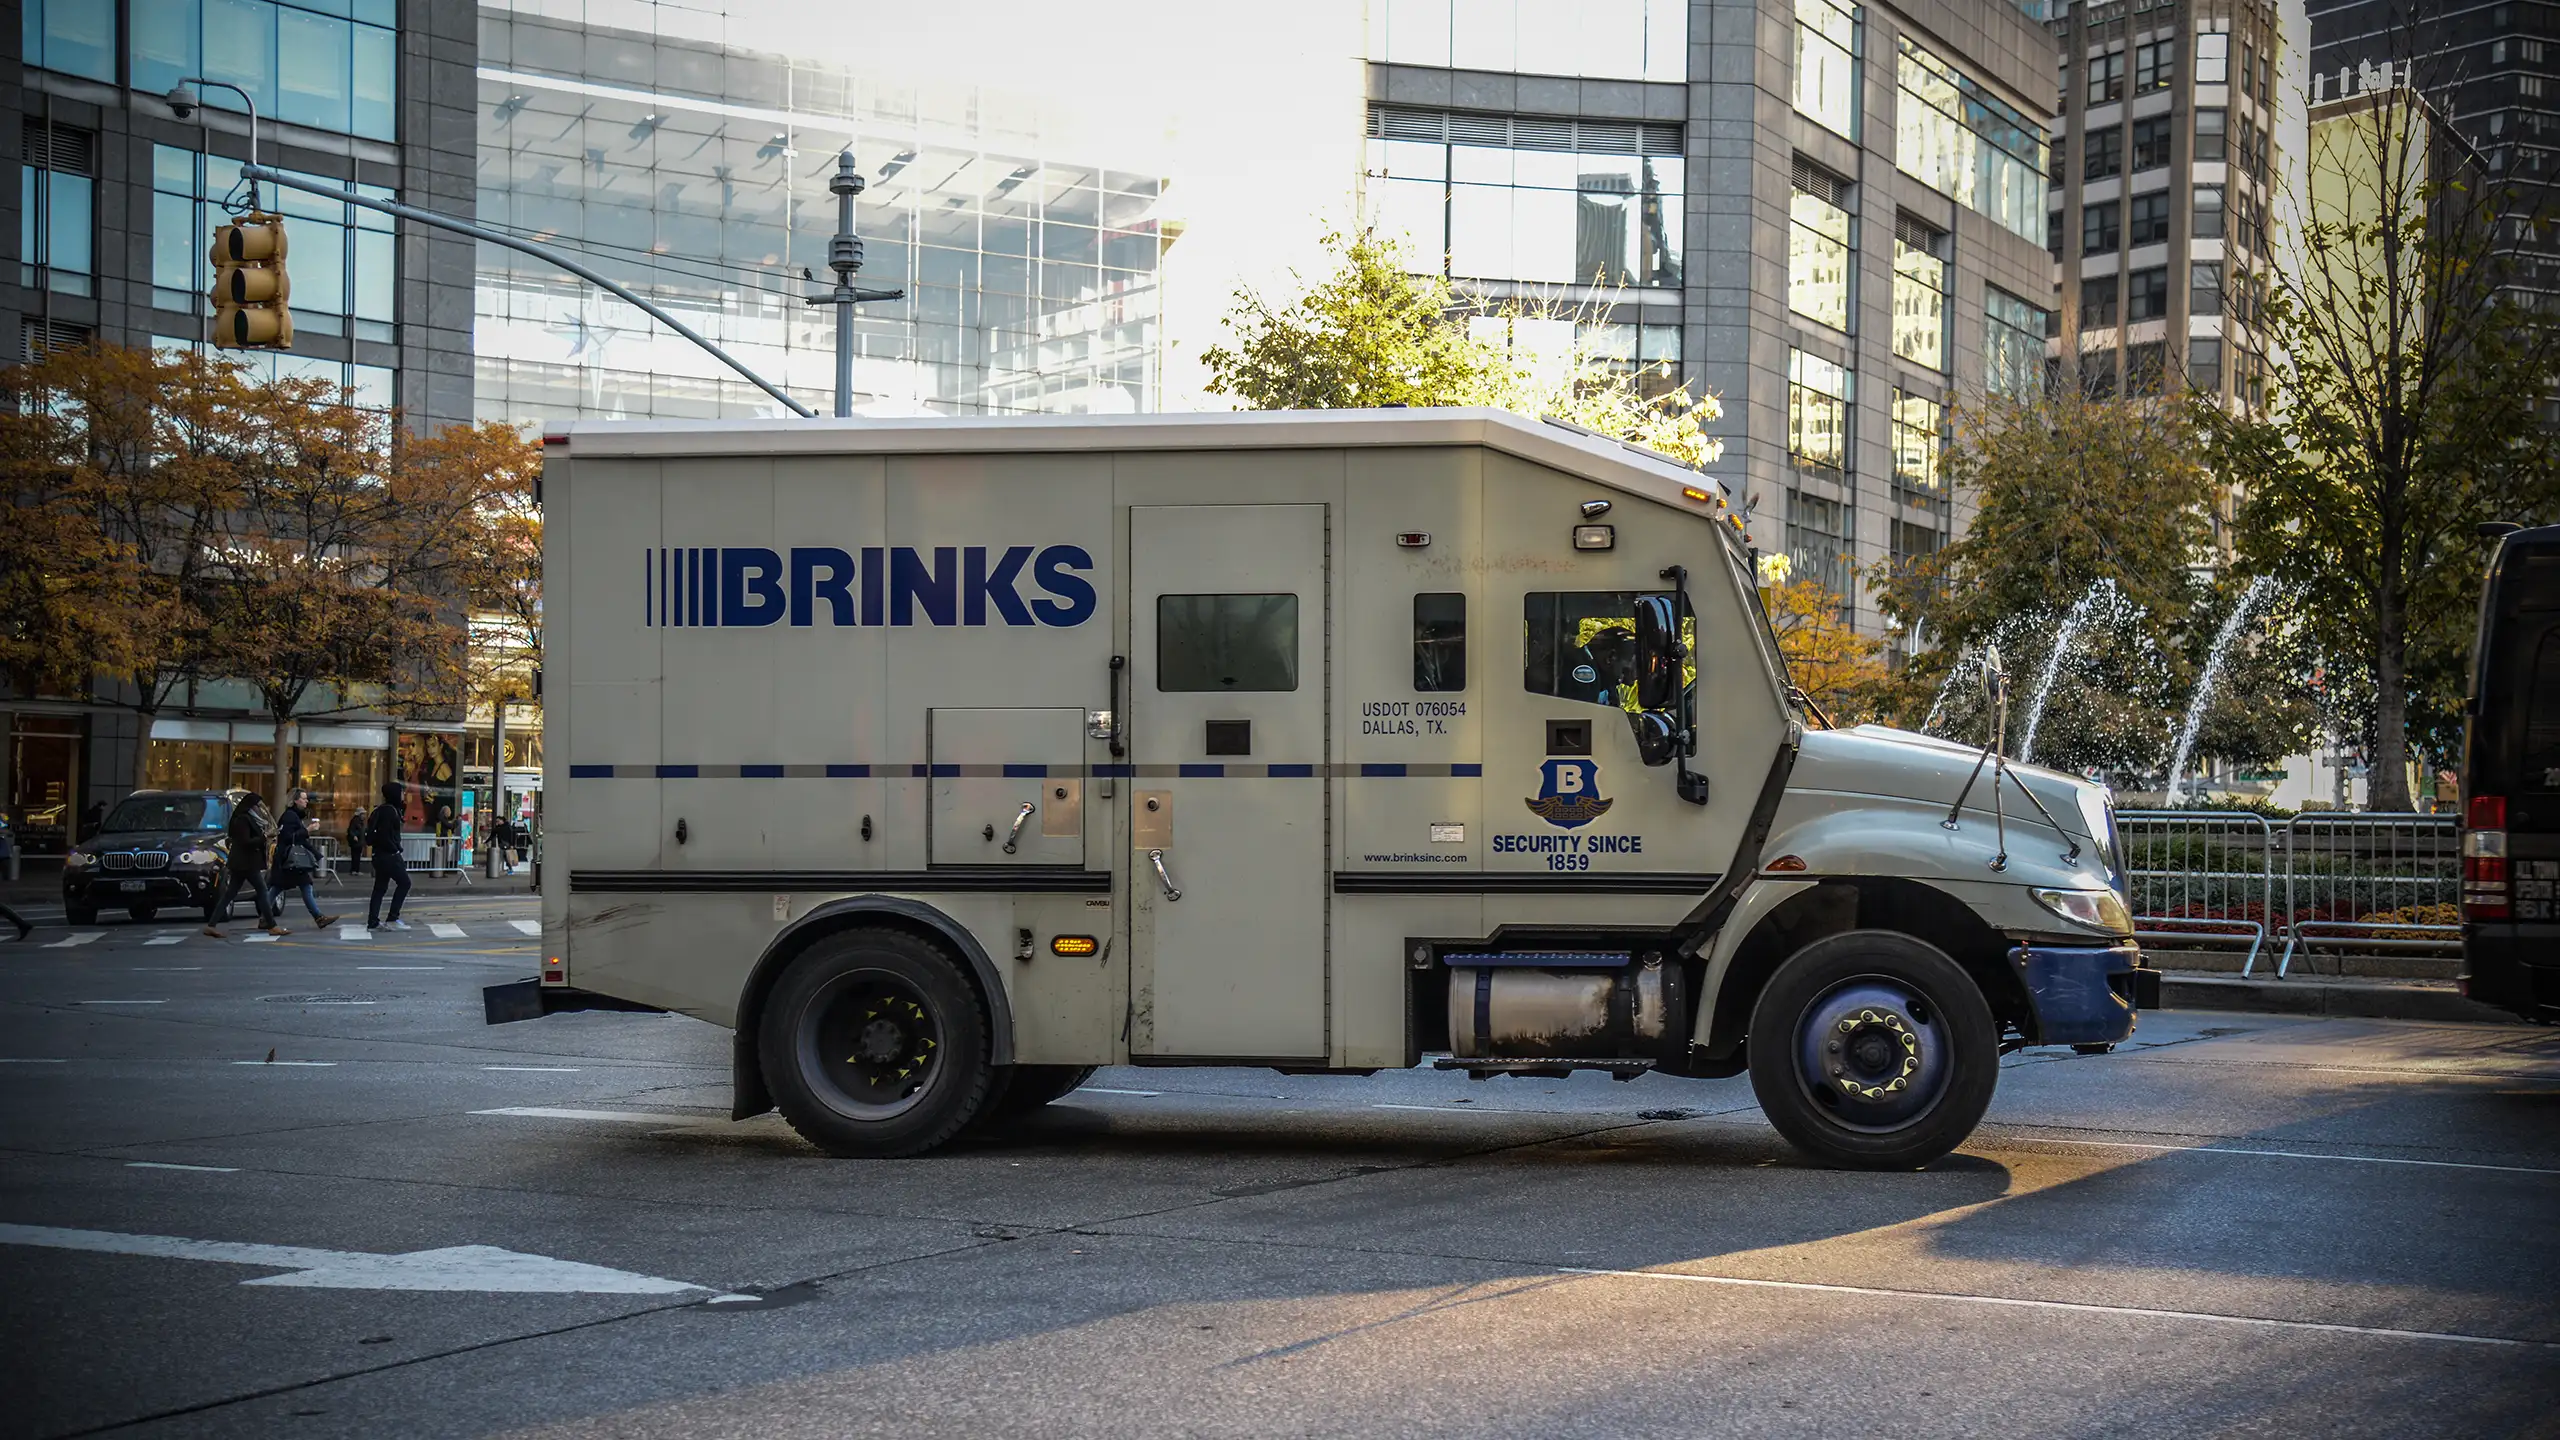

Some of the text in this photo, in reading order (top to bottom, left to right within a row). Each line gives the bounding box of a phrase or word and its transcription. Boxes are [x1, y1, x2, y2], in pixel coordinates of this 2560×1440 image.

[720, 544, 1097, 628] BRINKS
[1362, 702, 1467, 717] USDOT 076054
[1362, 720, 1447, 737] DALLAS, TX.
[1556, 764, 1584, 794] B
[1492, 834, 1643, 853] SECURITY SINCE
[1364, 853, 1468, 863] www.brinksinc.com
[1546, 853, 1590, 871] 1859
